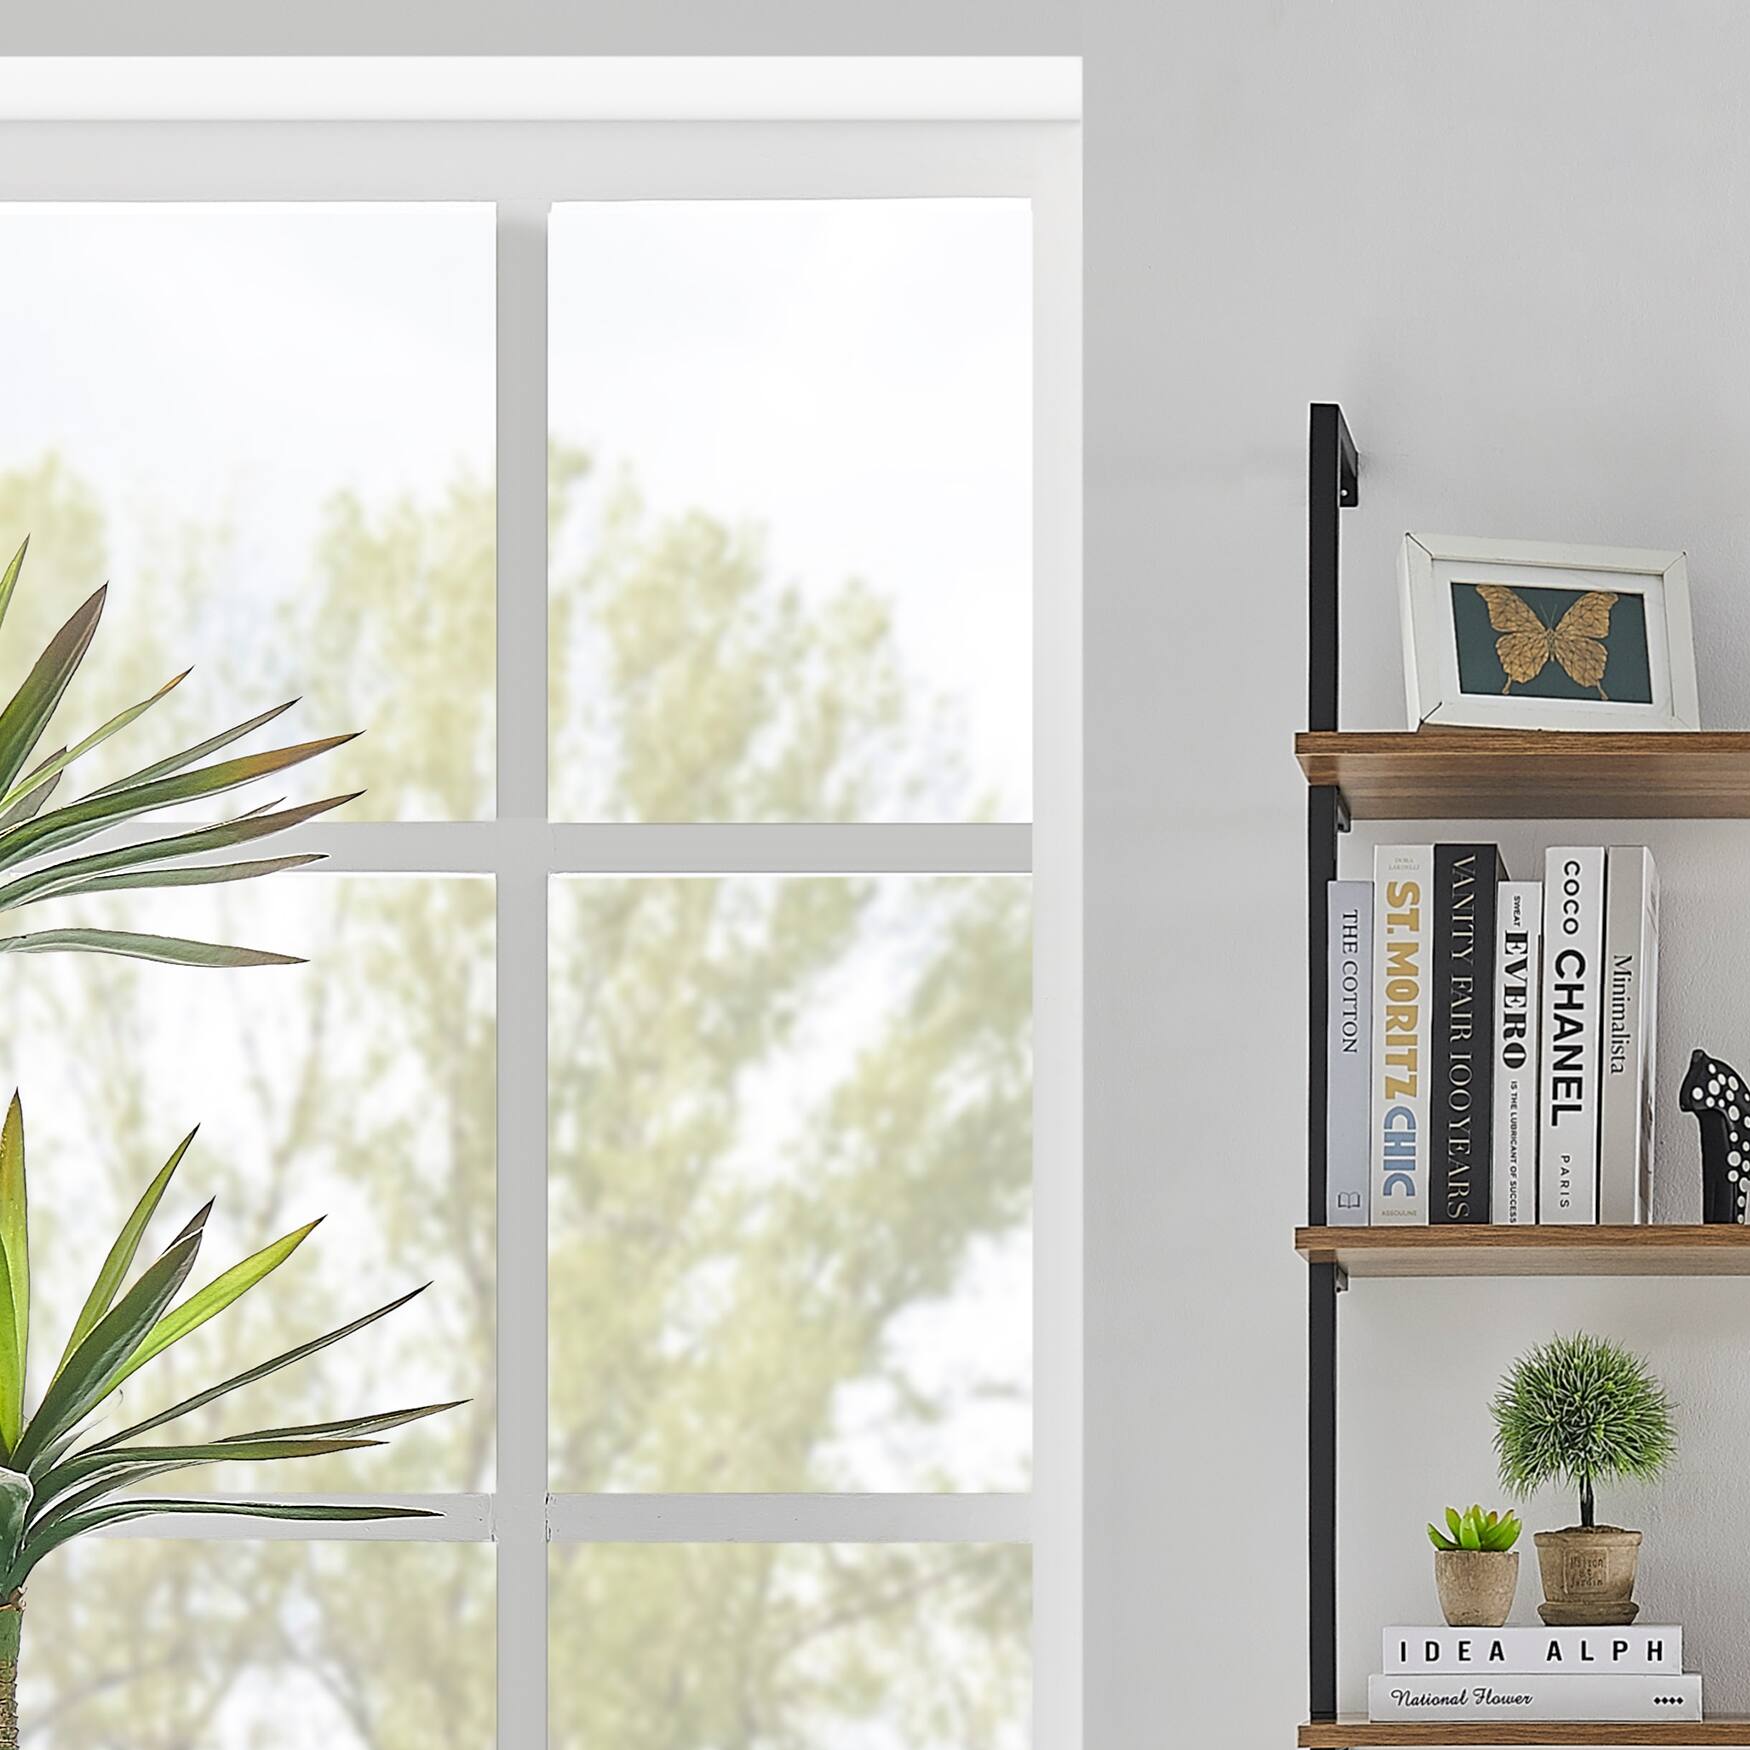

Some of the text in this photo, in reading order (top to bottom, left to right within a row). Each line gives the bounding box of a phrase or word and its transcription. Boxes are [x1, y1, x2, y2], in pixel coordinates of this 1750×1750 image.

[1385, 880, 1422, 935] ST.
[1451, 854, 1477, 966] VANITY
[1513, 895, 1522, 928] SWEAT
[1342, 908, 1359, 1054] THE COTTON
[1384, 941, 1421, 1101] MORITZ
[1449, 973, 1474, 1043] FAIR
[1610, 953, 1634, 1075] Minimalista
[1551, 859, 1587, 1209] COCO CHANEL PARIS
[1382, 1104, 1417, 1198] CHIC
[1446, 1116, 1472, 1221] YEARS
[1509, 1080, 1518, 1224] IS THE LUBRICANT OF SUCCESS
[1390, 1687, 1534, 1708] National Flower
[1400, 1640, 1664, 1662] IDEA ALPH
